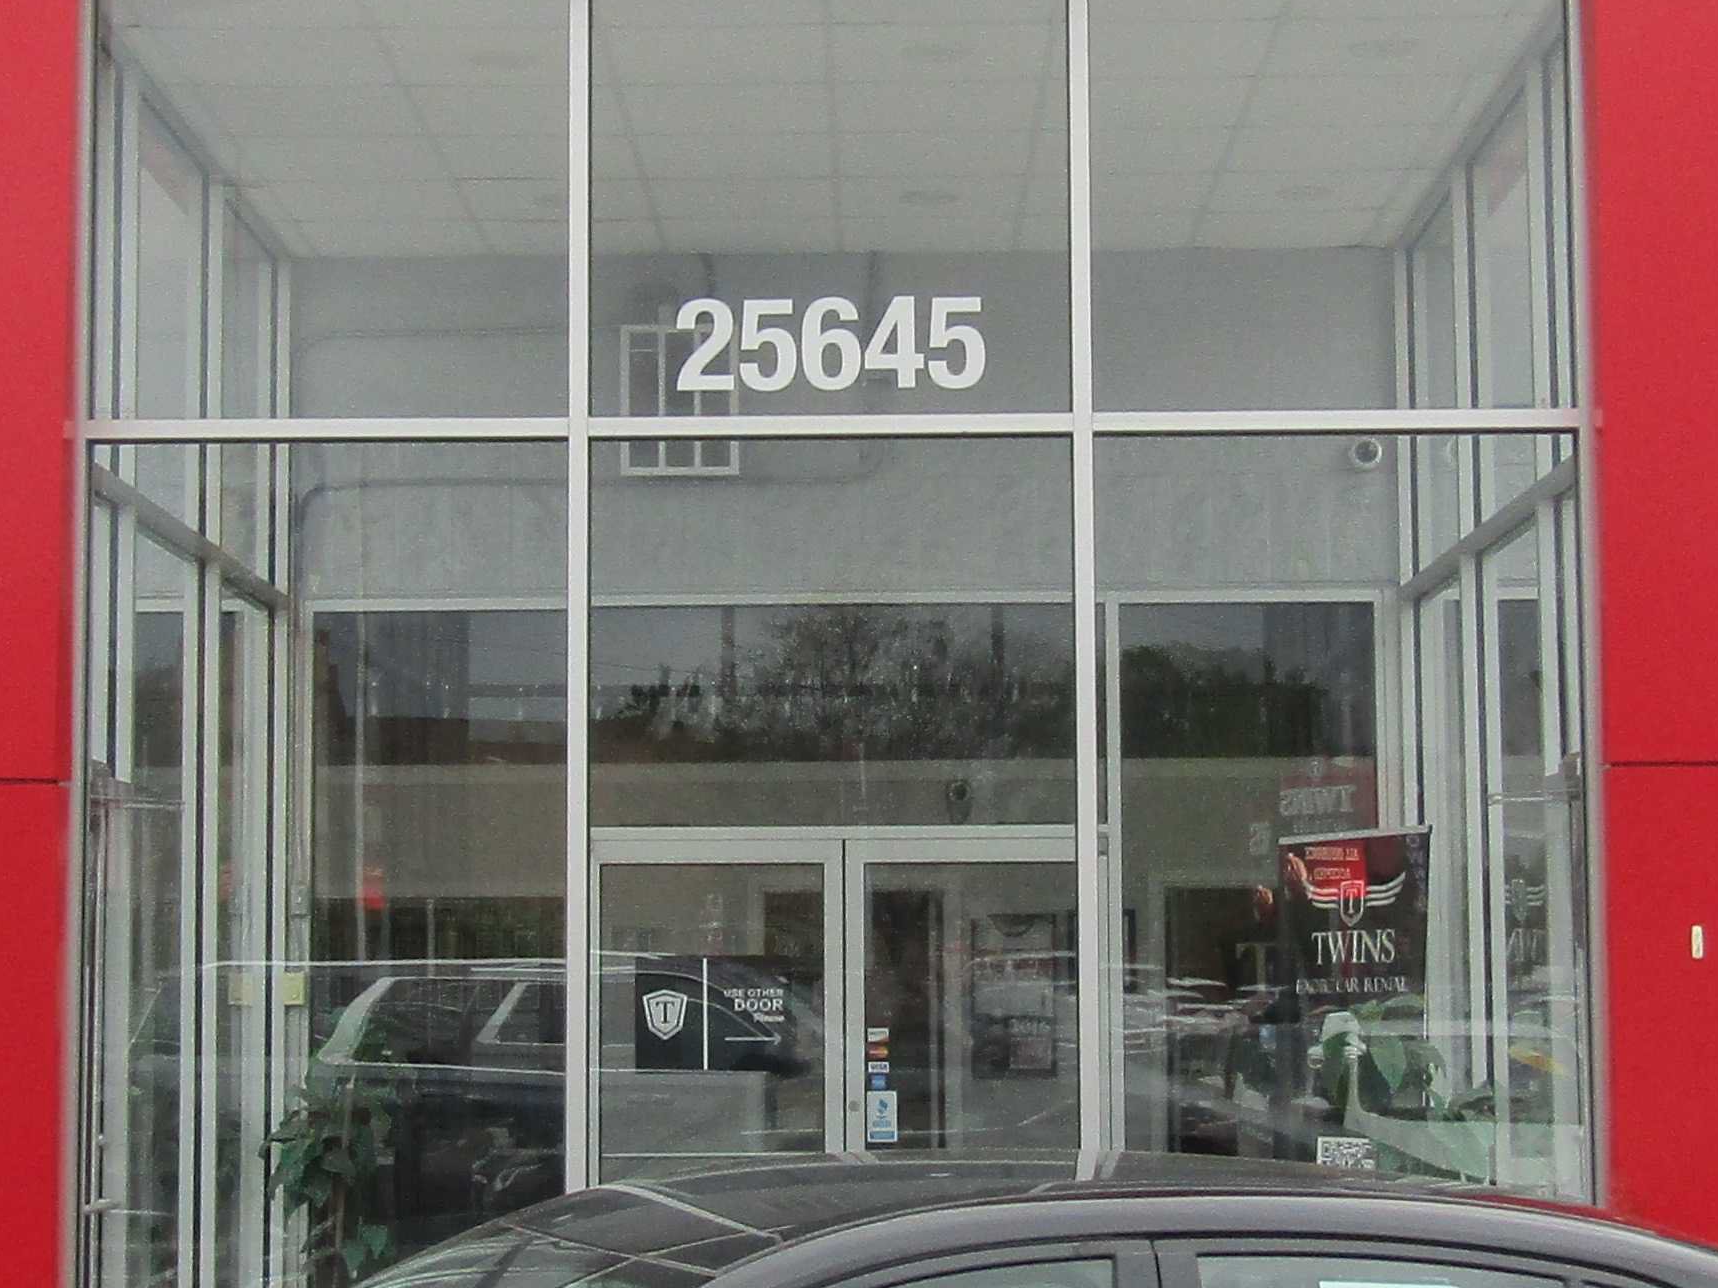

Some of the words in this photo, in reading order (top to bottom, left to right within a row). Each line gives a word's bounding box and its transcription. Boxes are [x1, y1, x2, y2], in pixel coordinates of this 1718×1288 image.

[675, 295, 986, 392] 25645
[1311, 927, 1396, 966] TWINS
[723, 988, 745, 998] USE
[747, 987, 784, 998] OTHER
[734, 998, 784, 1012] DOOR
[654, 1000, 676, 1025] T
